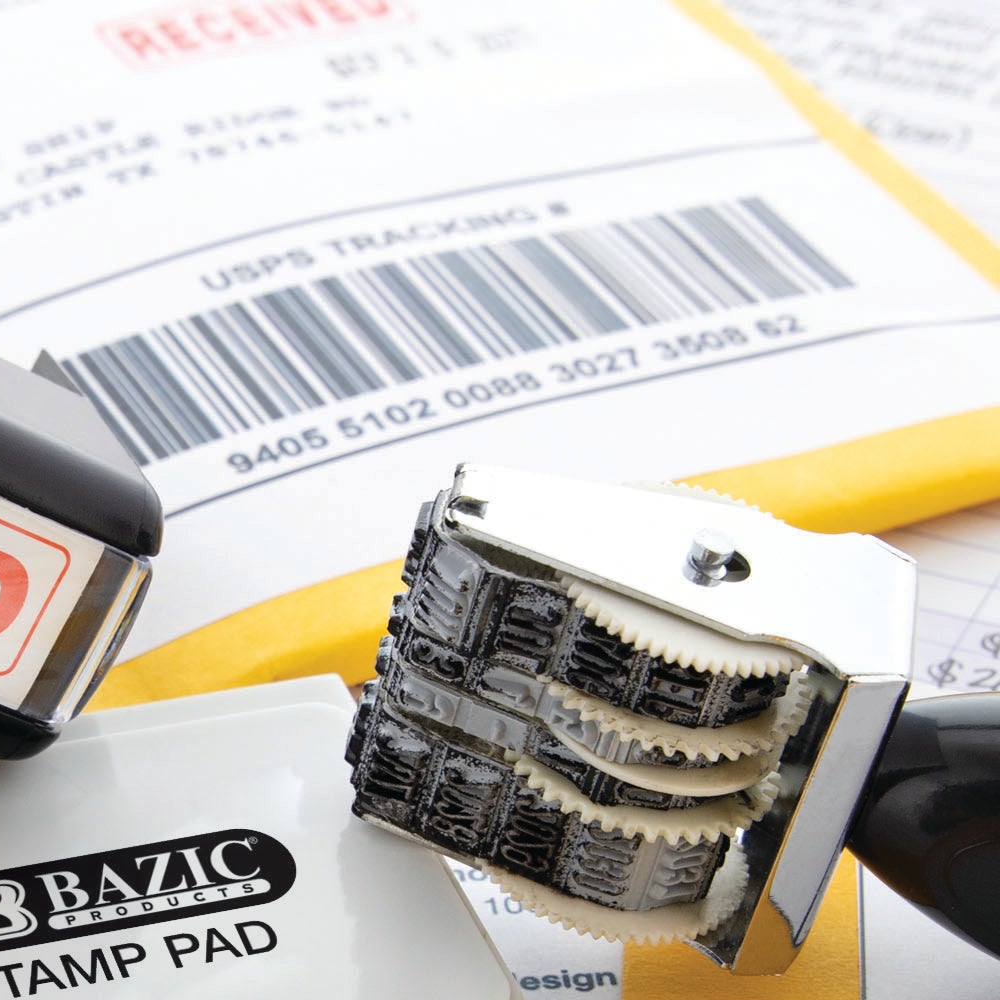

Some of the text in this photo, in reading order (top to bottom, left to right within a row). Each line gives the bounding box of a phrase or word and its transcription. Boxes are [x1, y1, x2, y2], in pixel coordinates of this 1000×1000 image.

[199, 247, 316, 293] USPS
[329, 205, 538, 260] TRACKING
[226, 314, 809, 476] 9405 5102 0088 3027 3508 62
[34, 838, 262, 914] BAZIC
[65, 883, 255, 927] PRODUCTS
[163, 919, 279, 970] PAD
[516, 969, 619, 992] esign
